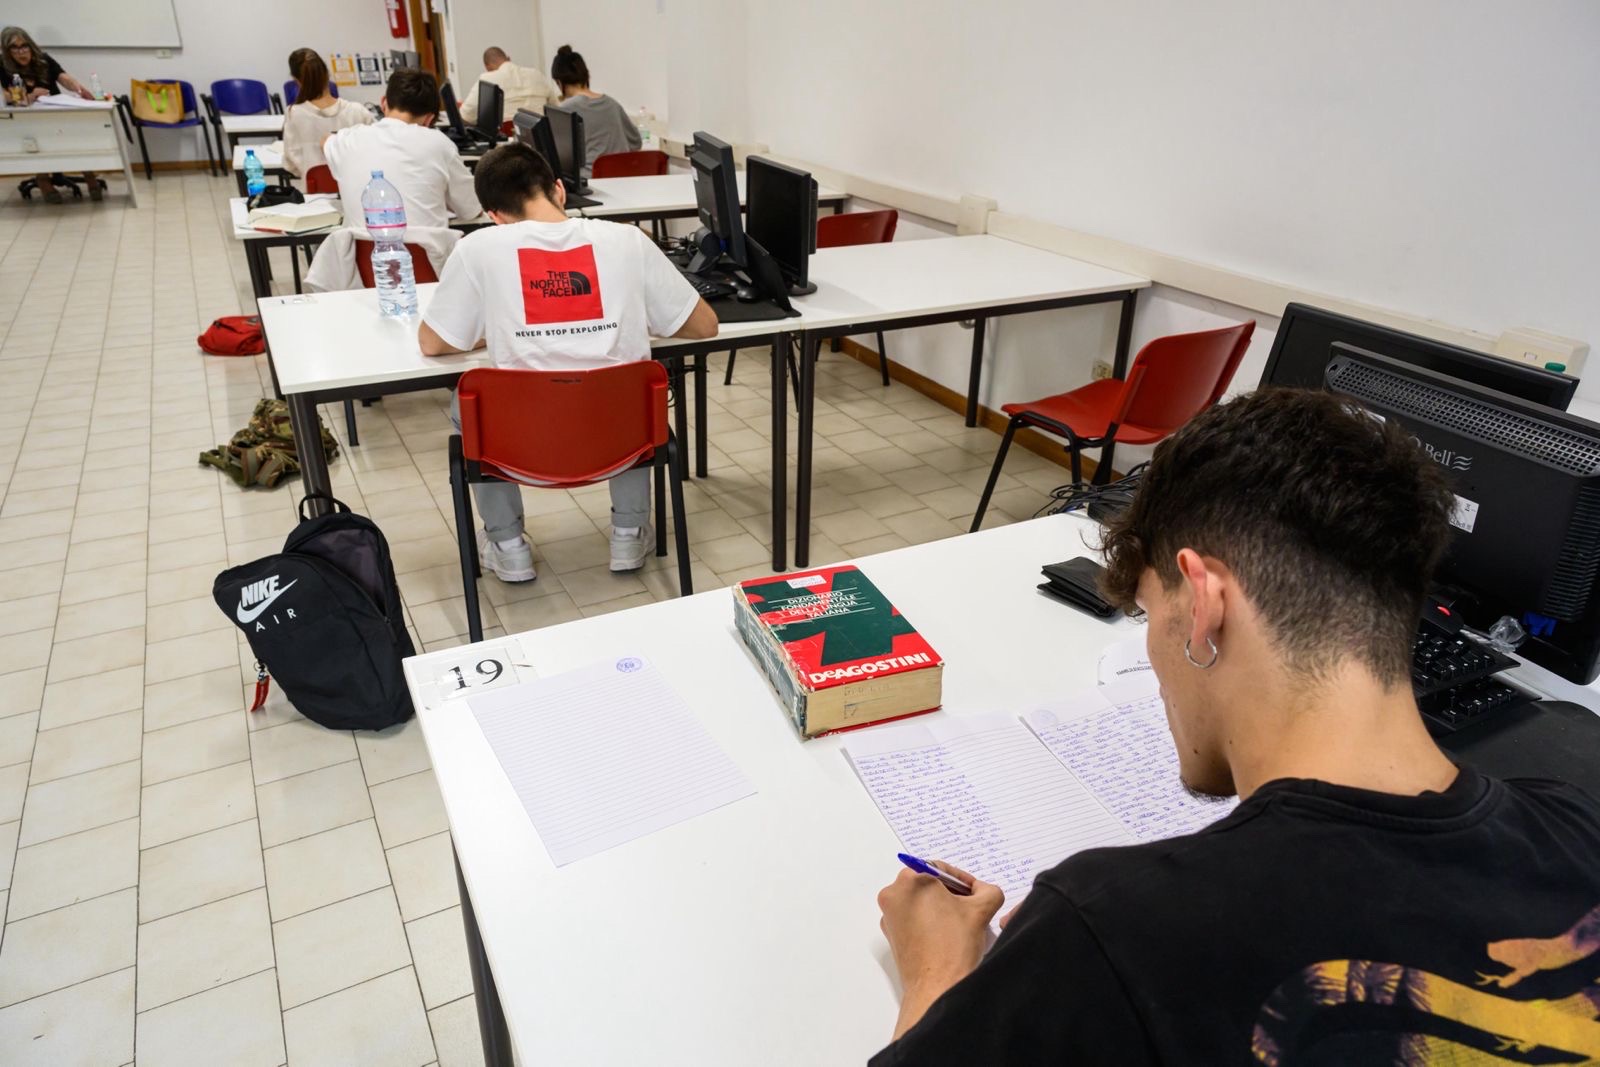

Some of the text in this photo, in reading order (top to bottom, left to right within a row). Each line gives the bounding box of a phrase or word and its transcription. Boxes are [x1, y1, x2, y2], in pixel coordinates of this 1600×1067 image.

[546, 270, 569, 280] THE
[530, 280, 570, 290] NORTH
[542, 287, 572, 298] FACE
[515, 329, 542, 337] NEVER
[570, 322, 618, 334] EXPLORING
[1425, 443, 1452, 466] Bell
[241, 574, 280, 608] NIKE
[787, 591, 843, 605] DIZIONARIO
[781, 594, 856, 611] FONDAMENTALE
[789, 600, 858, 616] DELLA LINGUA
[255, 608, 297, 633] AIR
